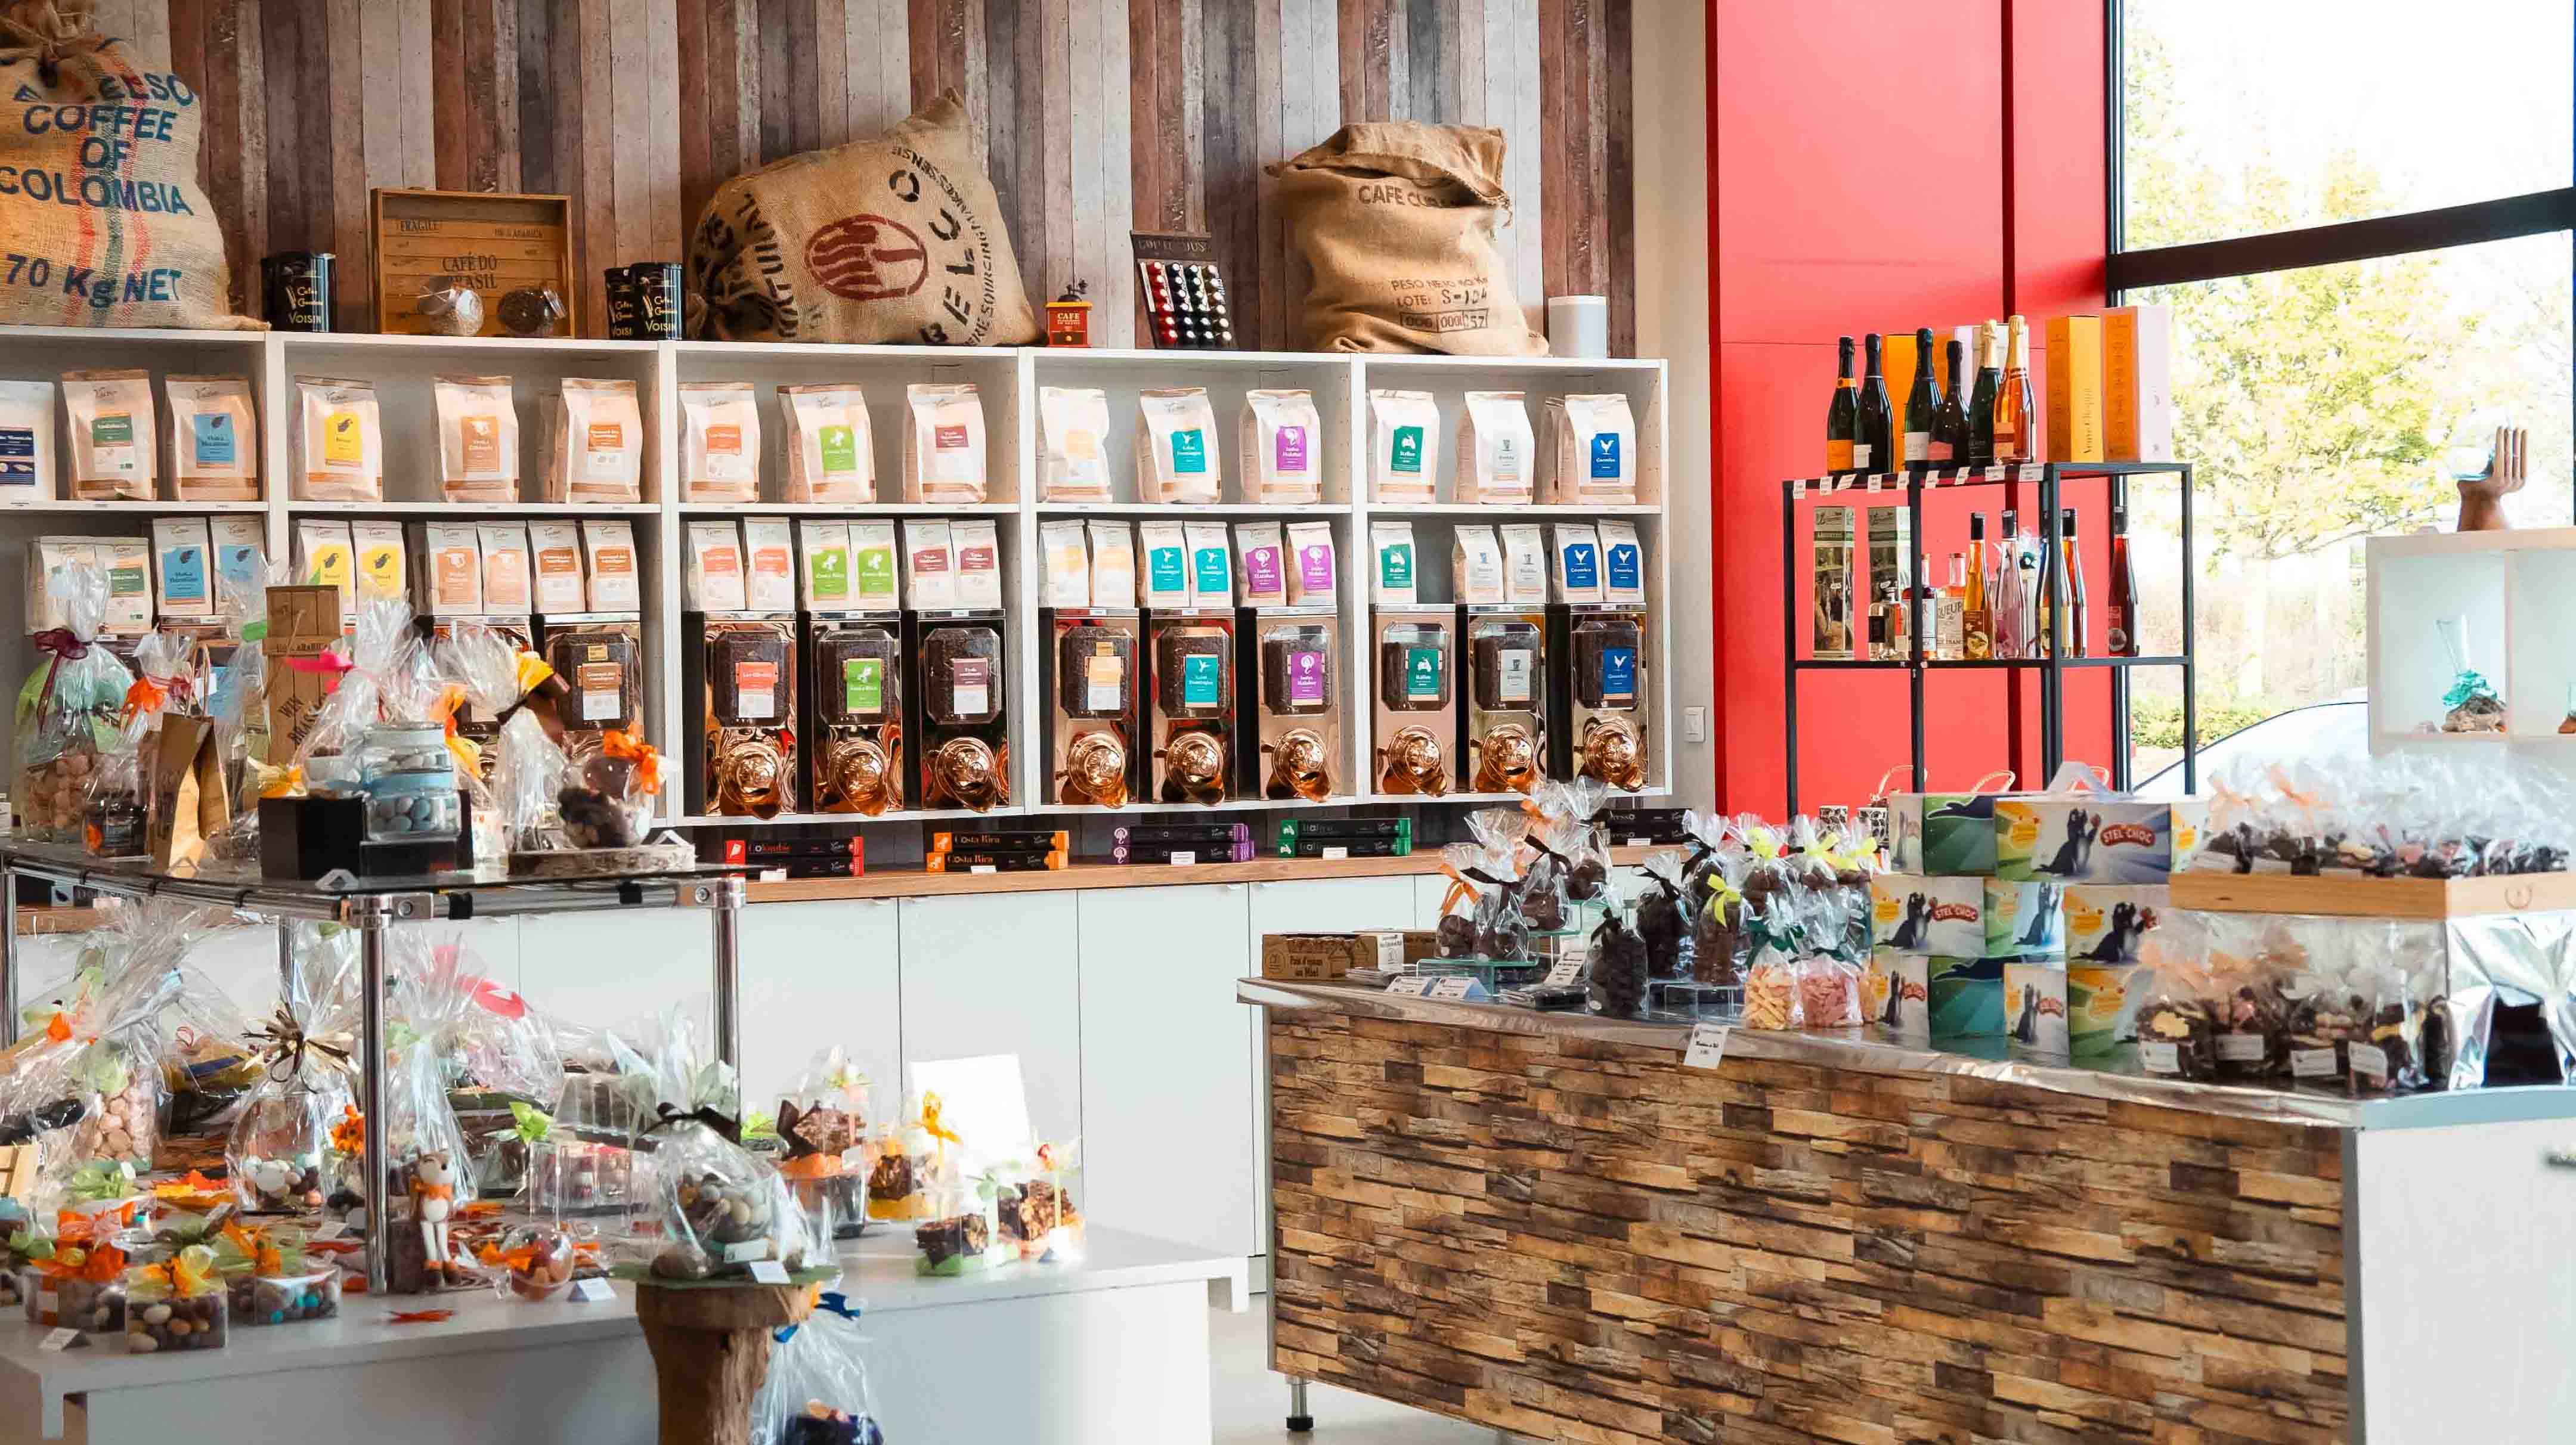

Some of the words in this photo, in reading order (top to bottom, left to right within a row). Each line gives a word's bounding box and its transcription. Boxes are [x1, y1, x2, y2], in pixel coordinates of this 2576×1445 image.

[24, 104, 177, 142] COFFEE
[80, 136, 131, 171] OF
[0, 166, 194, 216] COLOMBIA
[1358, 184, 1405, 205] CAFE
[5, 253, 50, 287] 70
[123, 267, 182, 302] NET
[1391, 279, 1424, 291] PESO
[611, 325, 633, 336] VOISI
